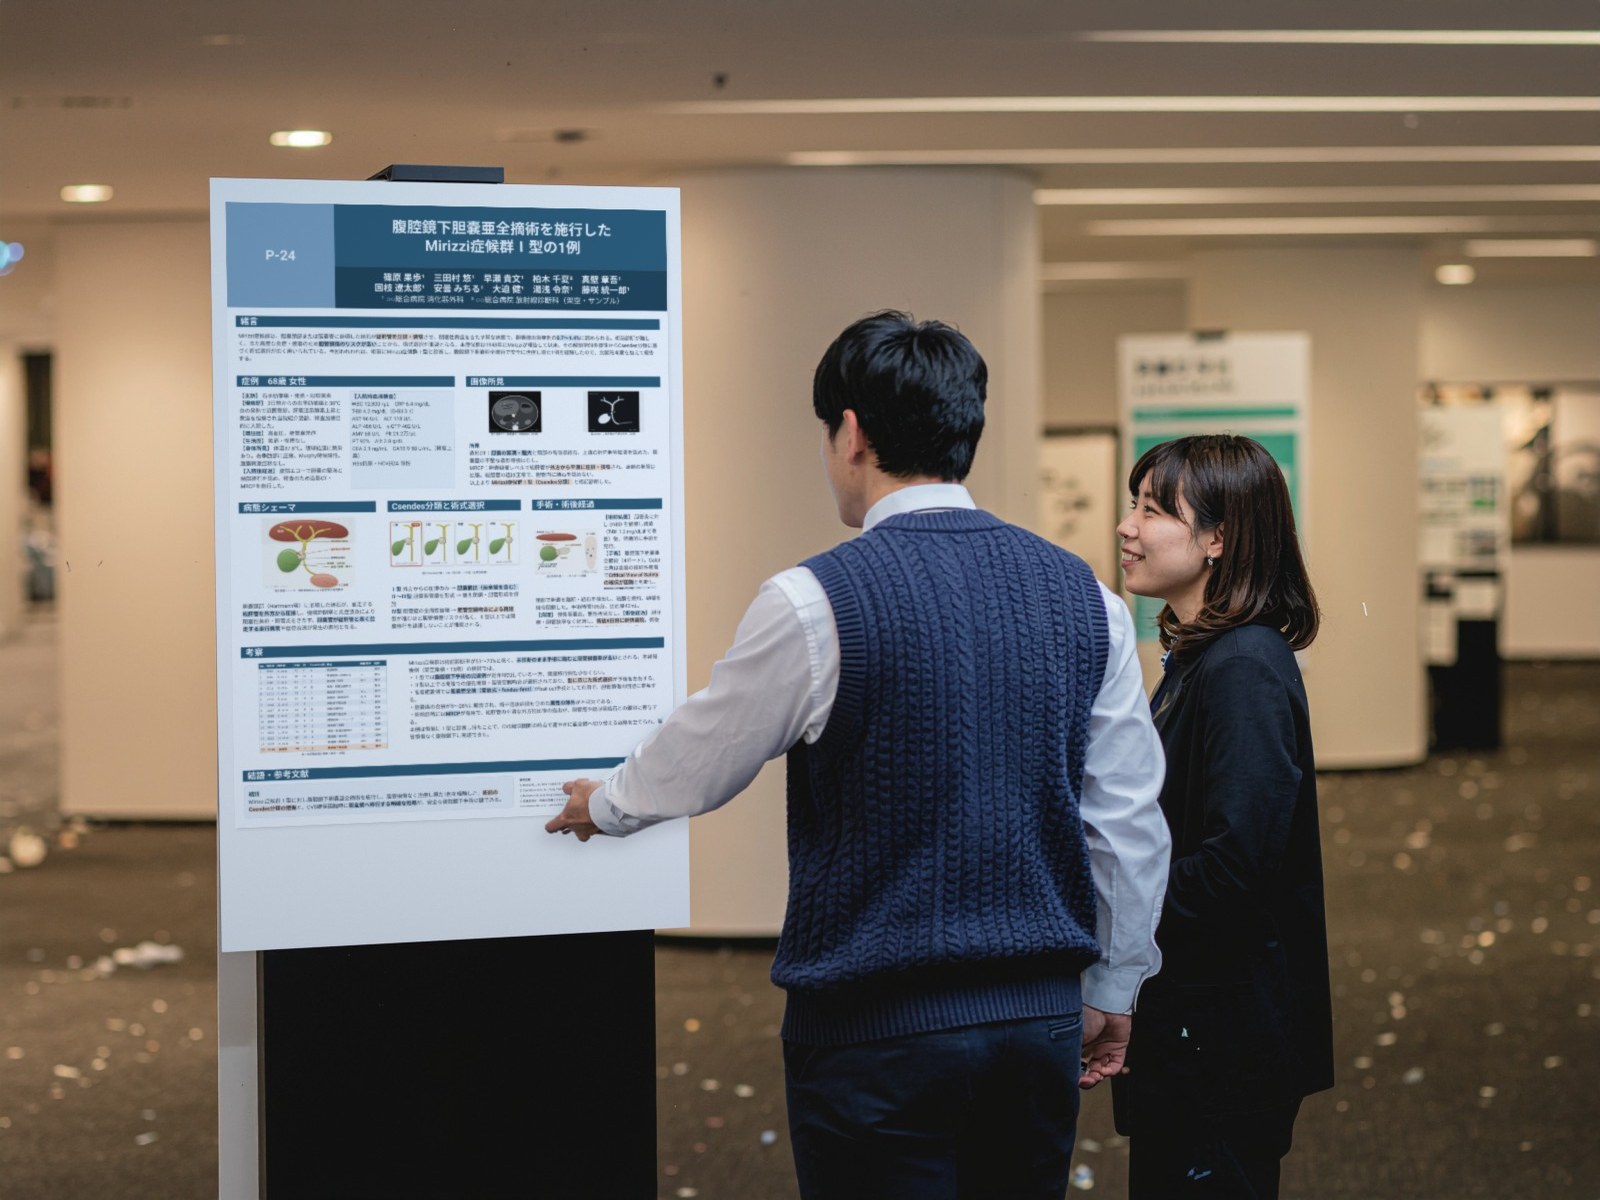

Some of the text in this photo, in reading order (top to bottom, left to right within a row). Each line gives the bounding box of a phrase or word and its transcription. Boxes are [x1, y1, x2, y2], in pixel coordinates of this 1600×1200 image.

[392, 219, 611, 237] 腹腔鏡下胆嚢亜全摘術を施行した
[265, 249, 296, 261] P-24
[241, 377, 307, 386] 症例 68歳 女性
[470, 377, 504, 386] 画像所見
